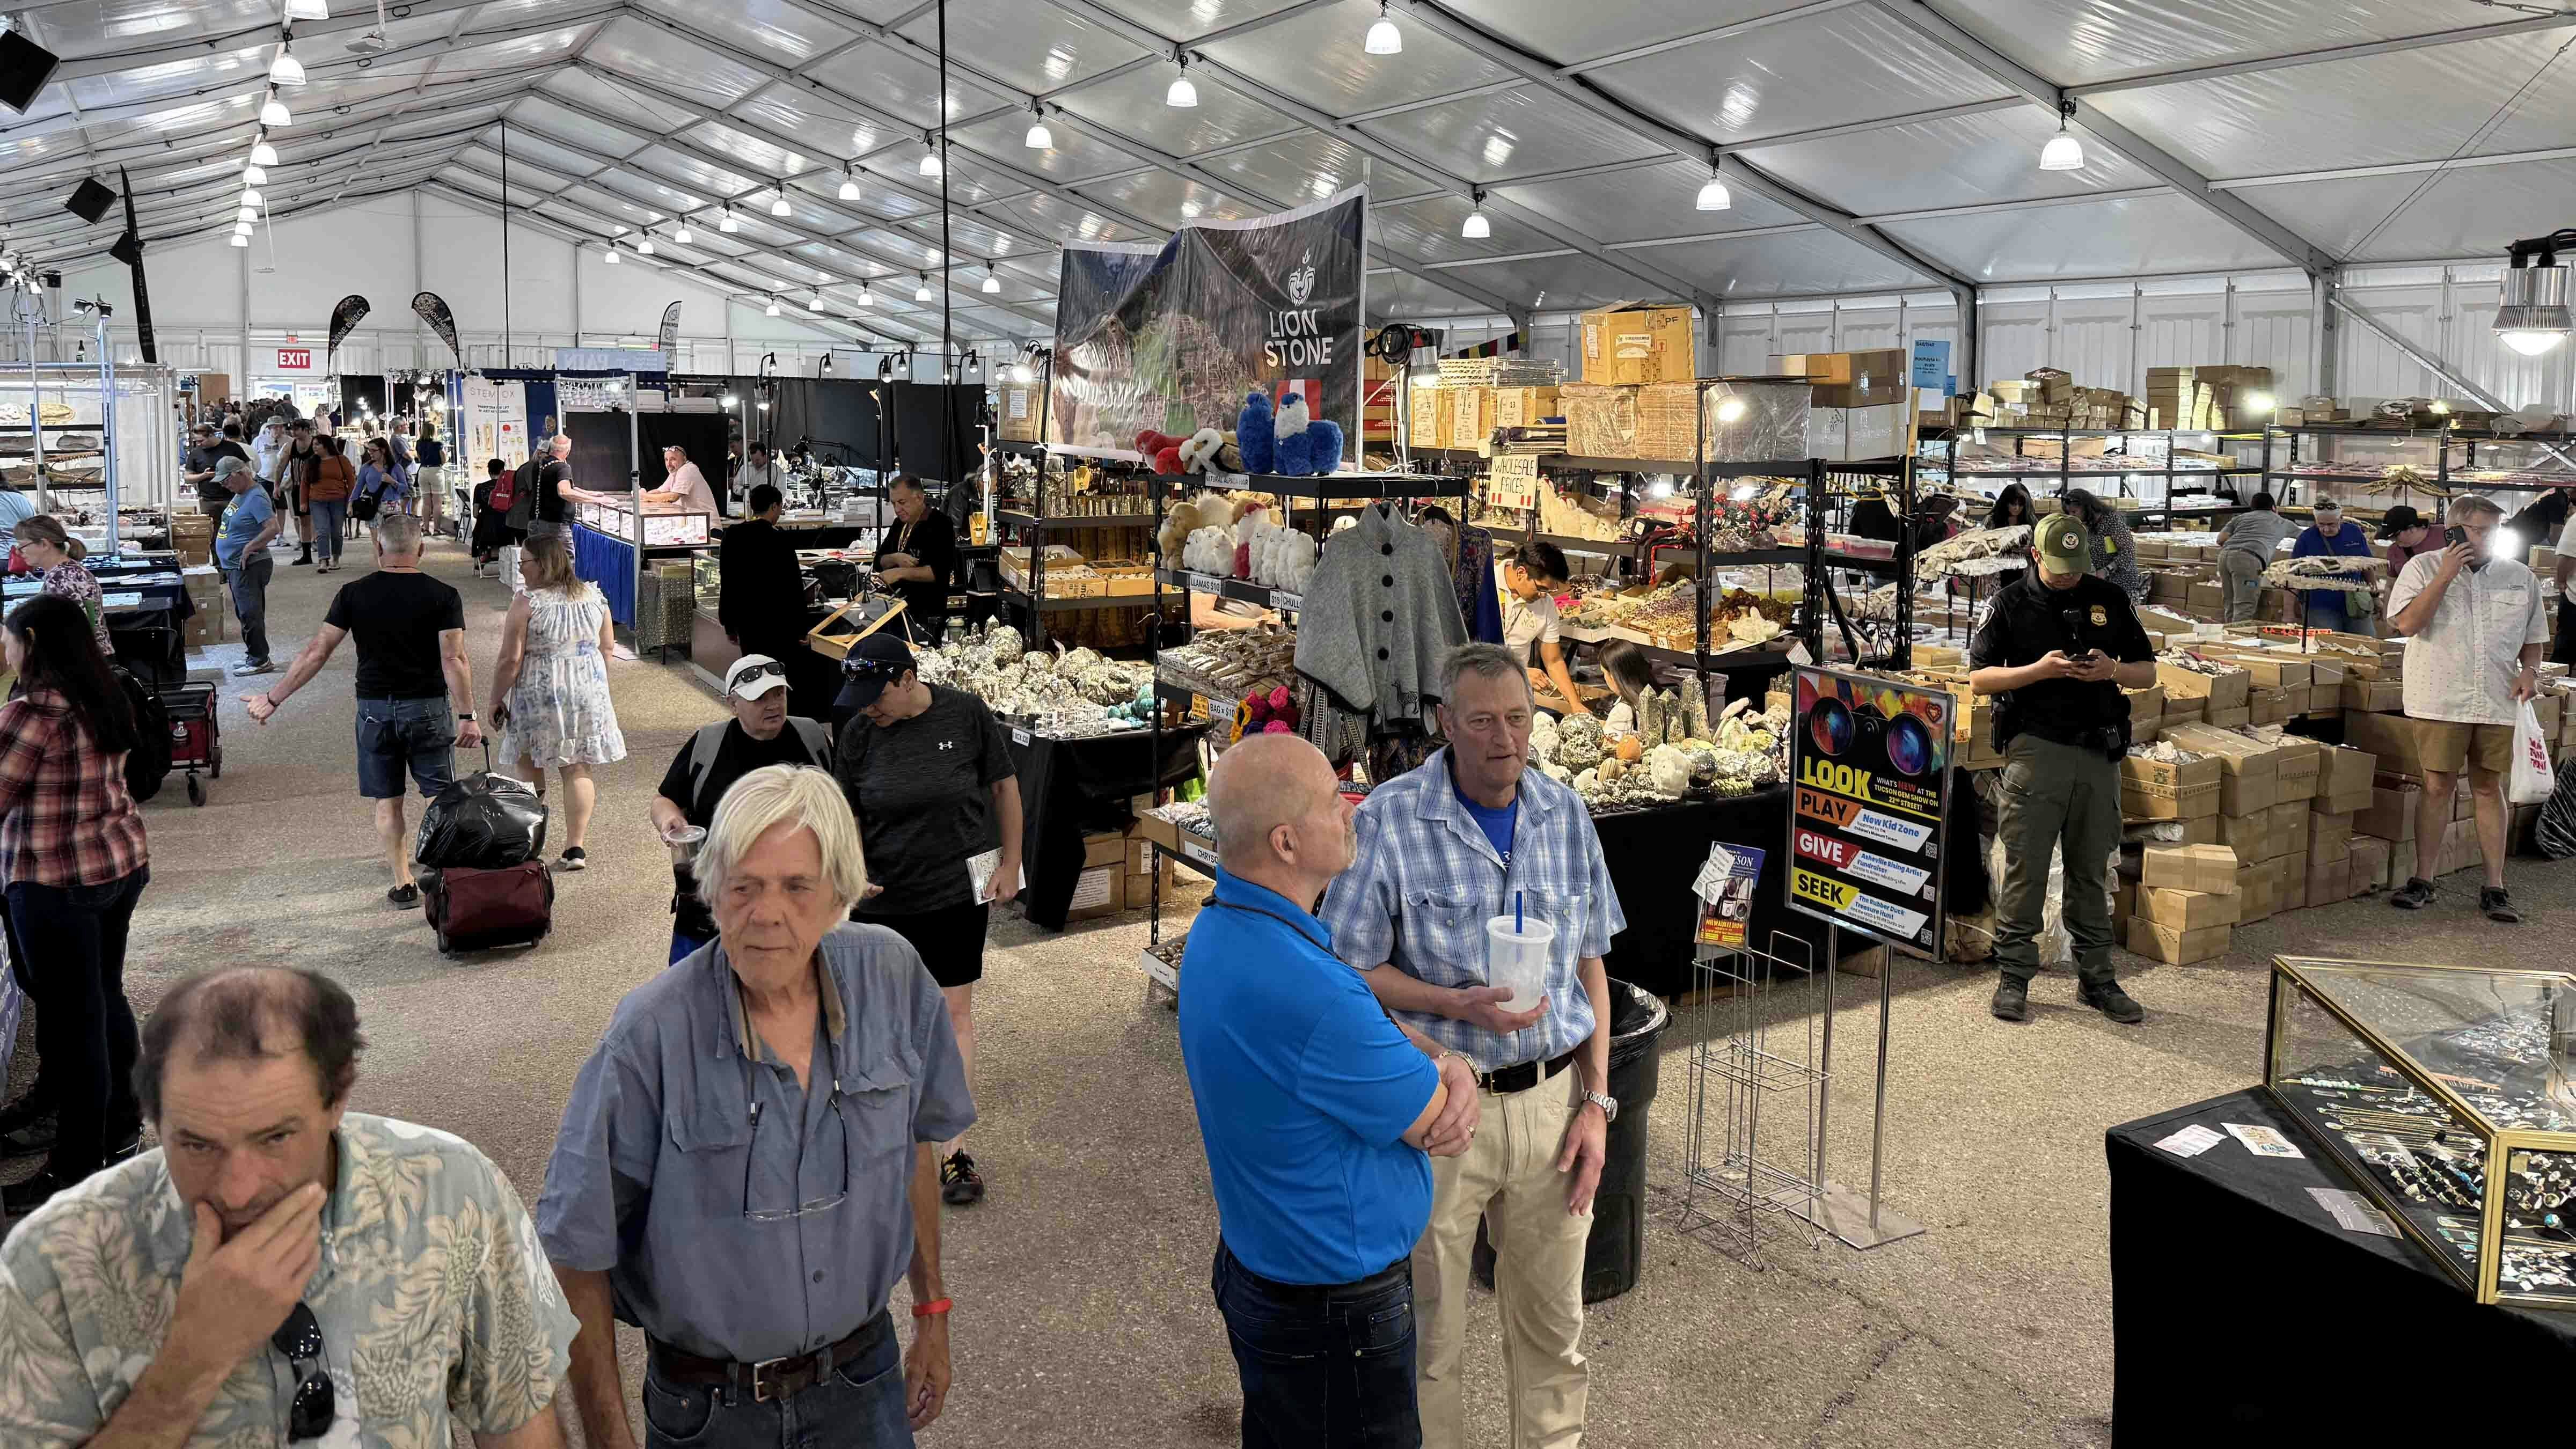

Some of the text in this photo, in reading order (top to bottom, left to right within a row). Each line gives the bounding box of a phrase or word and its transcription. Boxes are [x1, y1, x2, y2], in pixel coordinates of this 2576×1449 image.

[333, 308, 366, 344] MINE DIRECT
[425, 305, 451, 333] WHOLESALE
[425, 314, 436, 327] AND
[1270, 309, 1318, 337] LION
[279, 352, 309, 366] EXIT
[1264, 337, 1334, 368] STONE
[1494, 458, 1535, 477] WHOLESALE
[1501, 477, 1525, 494] PRICES
[1191, 577, 1220, 592] LLAMAS $10
[1271, 595, 1280, 605] $15
[1210, 703, 1220, 714] BAG
[1226, 708, 1235, 718] $10
[1804, 755, 1872, 800] LOOK
[1876, 777, 1898, 788] WHAT'S
[1898, 781, 1916, 793] NEW
[1925, 789, 1937, 799] THE
[1875, 784, 1938, 807] TUCSON GEM SHOW ON
[1900, 800, 1923, 811] STREET!
[1801, 791, 1848, 824] PLAY
[1882, 818, 1898, 831] Kid
[1898, 823, 1920, 838] Zone
[1799, 835, 1843, 863] GIVE
[1857, 860, 1887, 874] Fundraiser
[1861, 853, 1887, 866] Asheville
[1887, 860, 1905, 873] Rising
[1905, 866, 1922, 877] Artist
[1797, 871, 1844, 905] SEEK
[1855, 902, 1879, 914] Treasure
[1879, 910, 1894, 920] Hunt
[1858, 895, 1905, 916] The Rubber Duck
